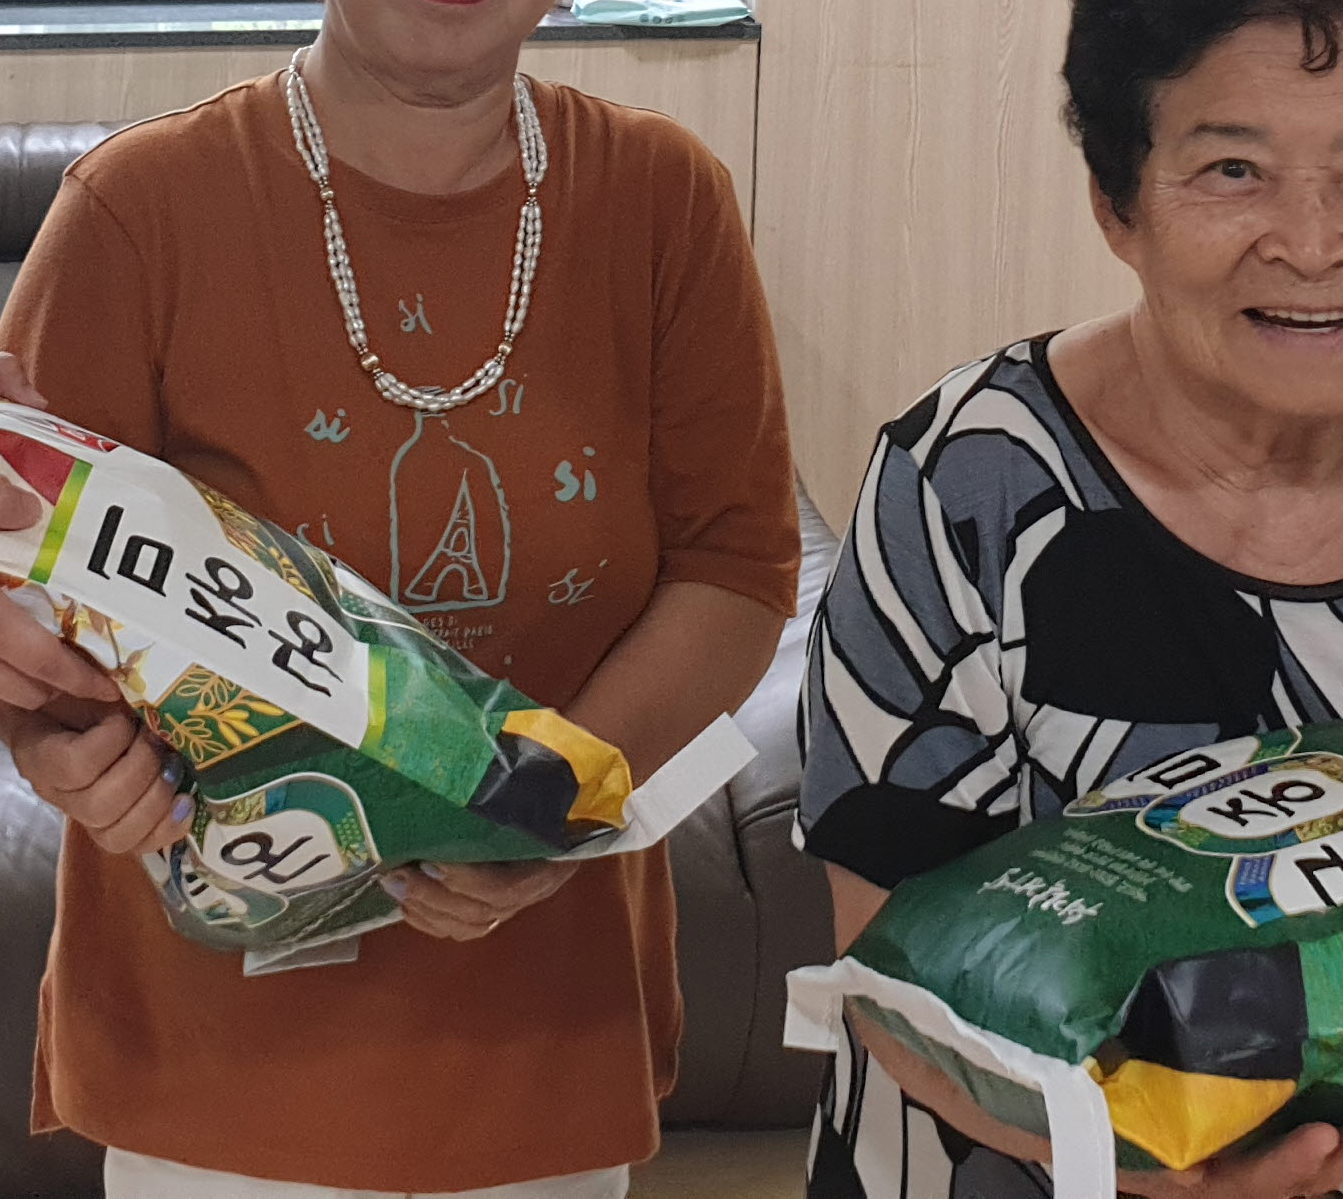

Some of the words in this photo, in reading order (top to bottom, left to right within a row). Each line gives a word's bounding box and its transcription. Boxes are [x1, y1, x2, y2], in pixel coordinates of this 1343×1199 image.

[305, 408, 351, 443] si
[554, 446, 597, 502] si
[86, 504, 344, 698] 궁중미
